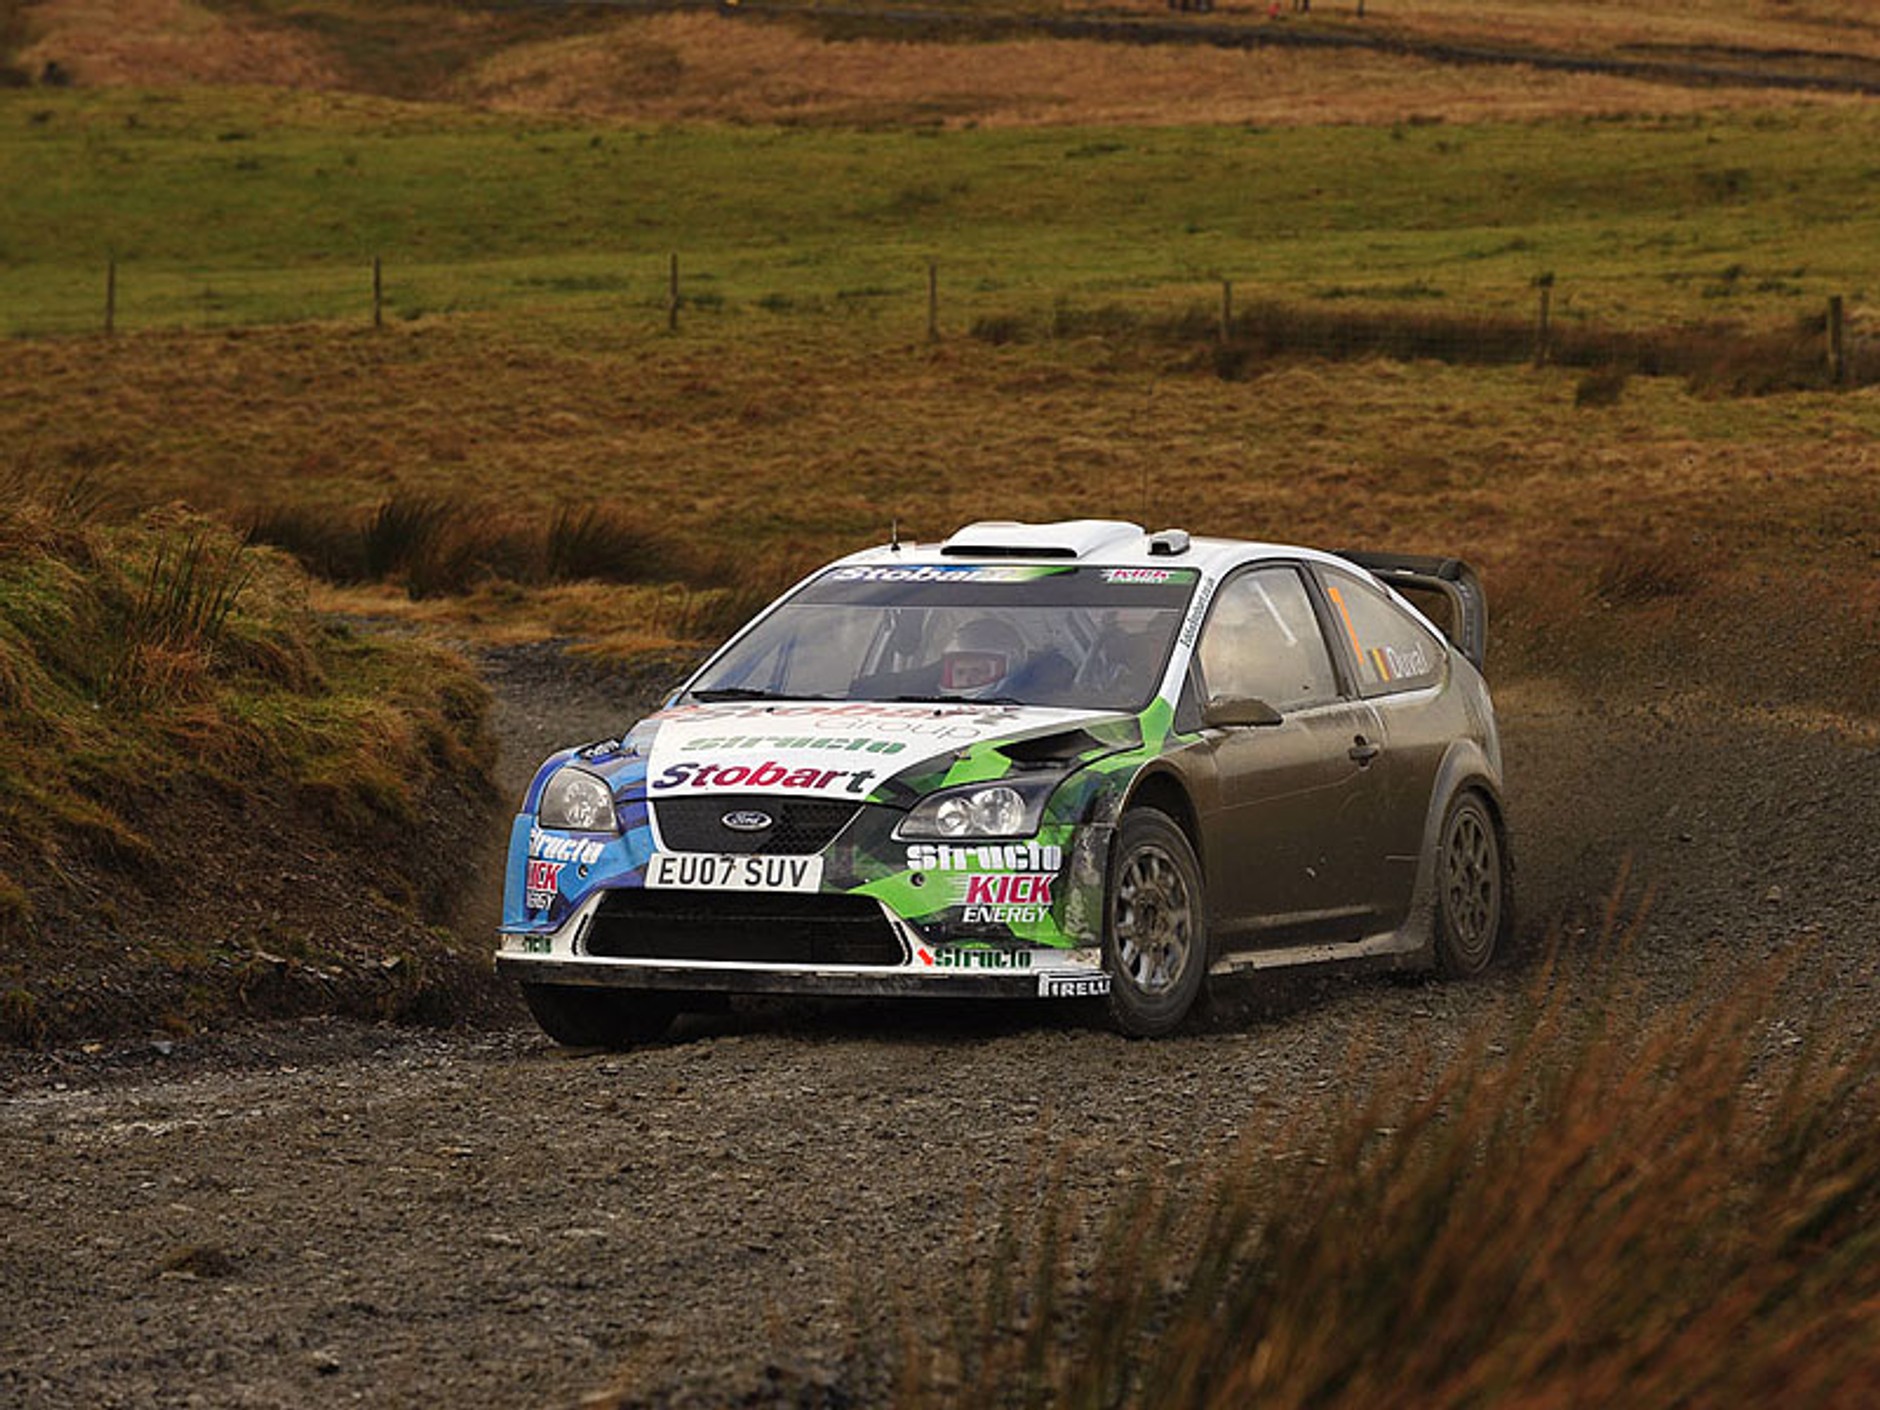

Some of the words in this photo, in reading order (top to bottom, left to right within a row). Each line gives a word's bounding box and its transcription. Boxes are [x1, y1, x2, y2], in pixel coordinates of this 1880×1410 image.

[652, 761, 875, 794] Stobart
[658, 857, 735, 885] EU07
[744, 859, 808, 887] SUV
[966, 876, 1053, 904] KICK
[963, 906, 1049, 924] ENERGY
